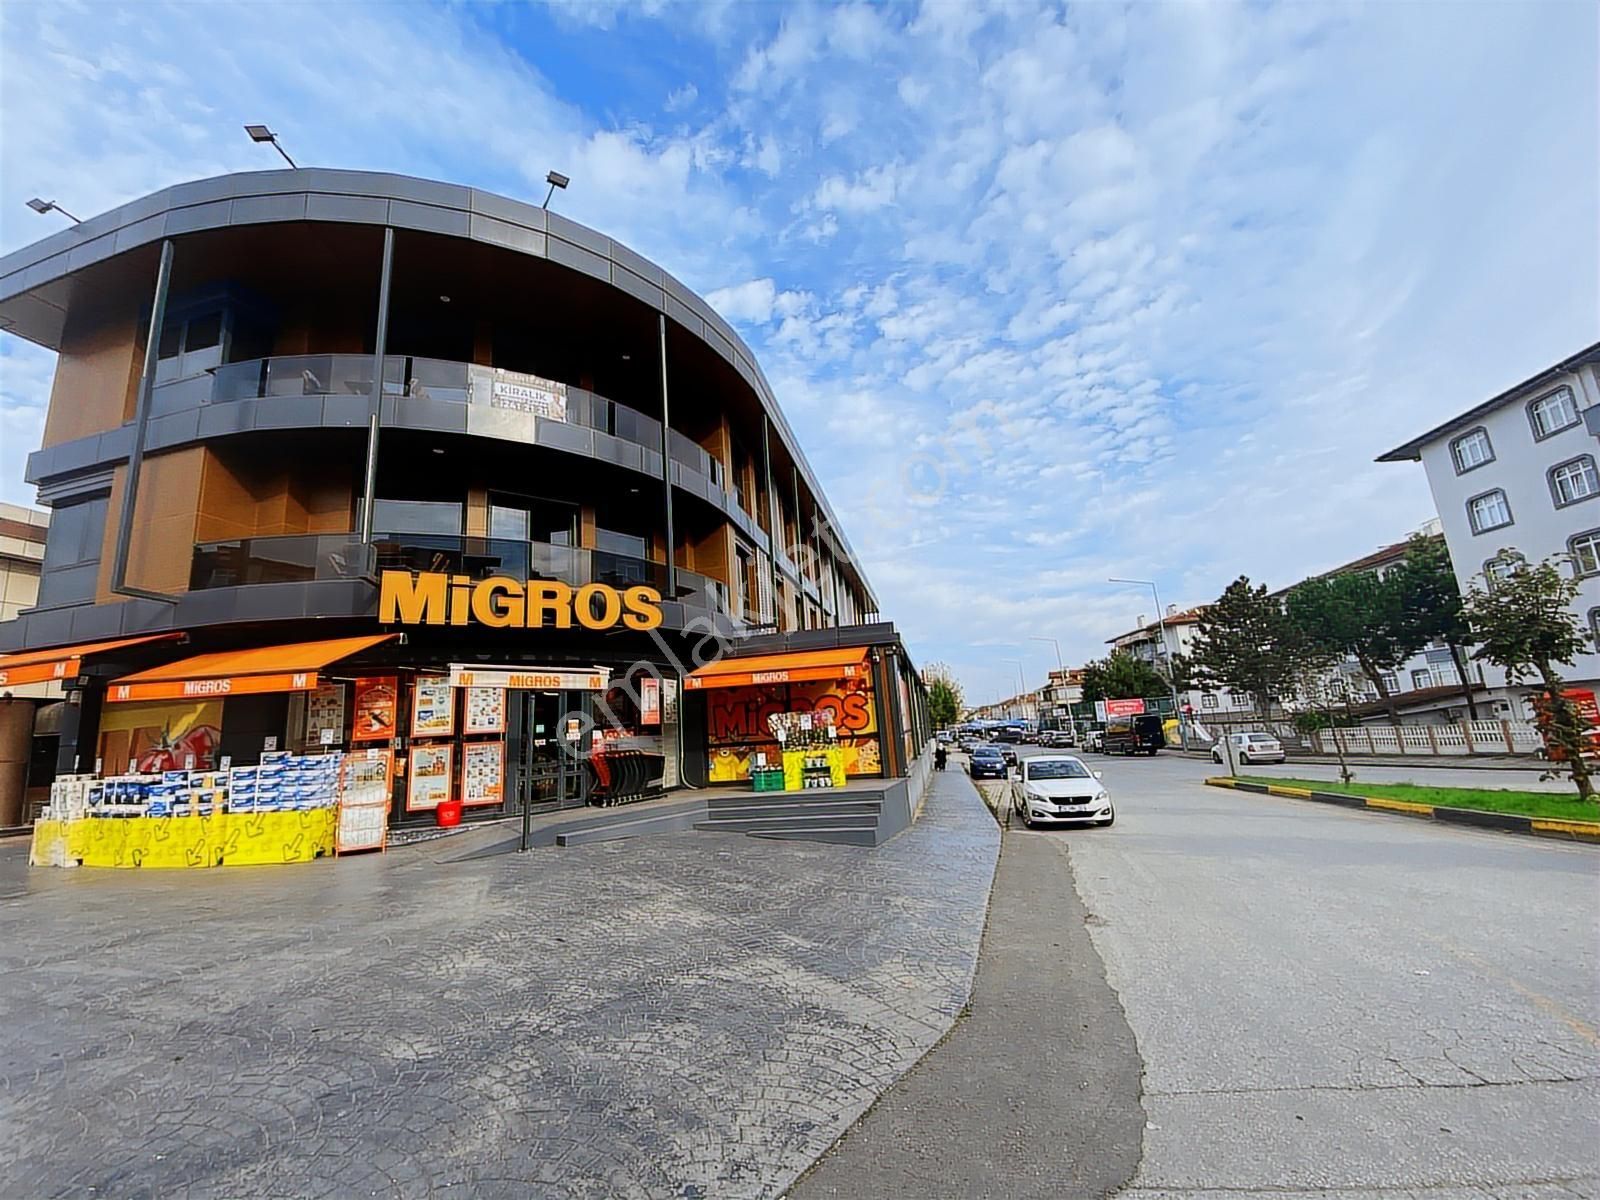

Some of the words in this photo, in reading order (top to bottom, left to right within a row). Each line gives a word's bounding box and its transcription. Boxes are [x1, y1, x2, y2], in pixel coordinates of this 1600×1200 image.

[500, 385, 547, 401] KIRALIK
[54, 661, 66, 679] M
[691, 677, 702, 689] M
[844, 665, 855, 677] M
[118, 685, 131, 699] M
[292, 673, 307, 688] M
[459, 673, 474, 686] M
[588, 675, 602, 688] M
